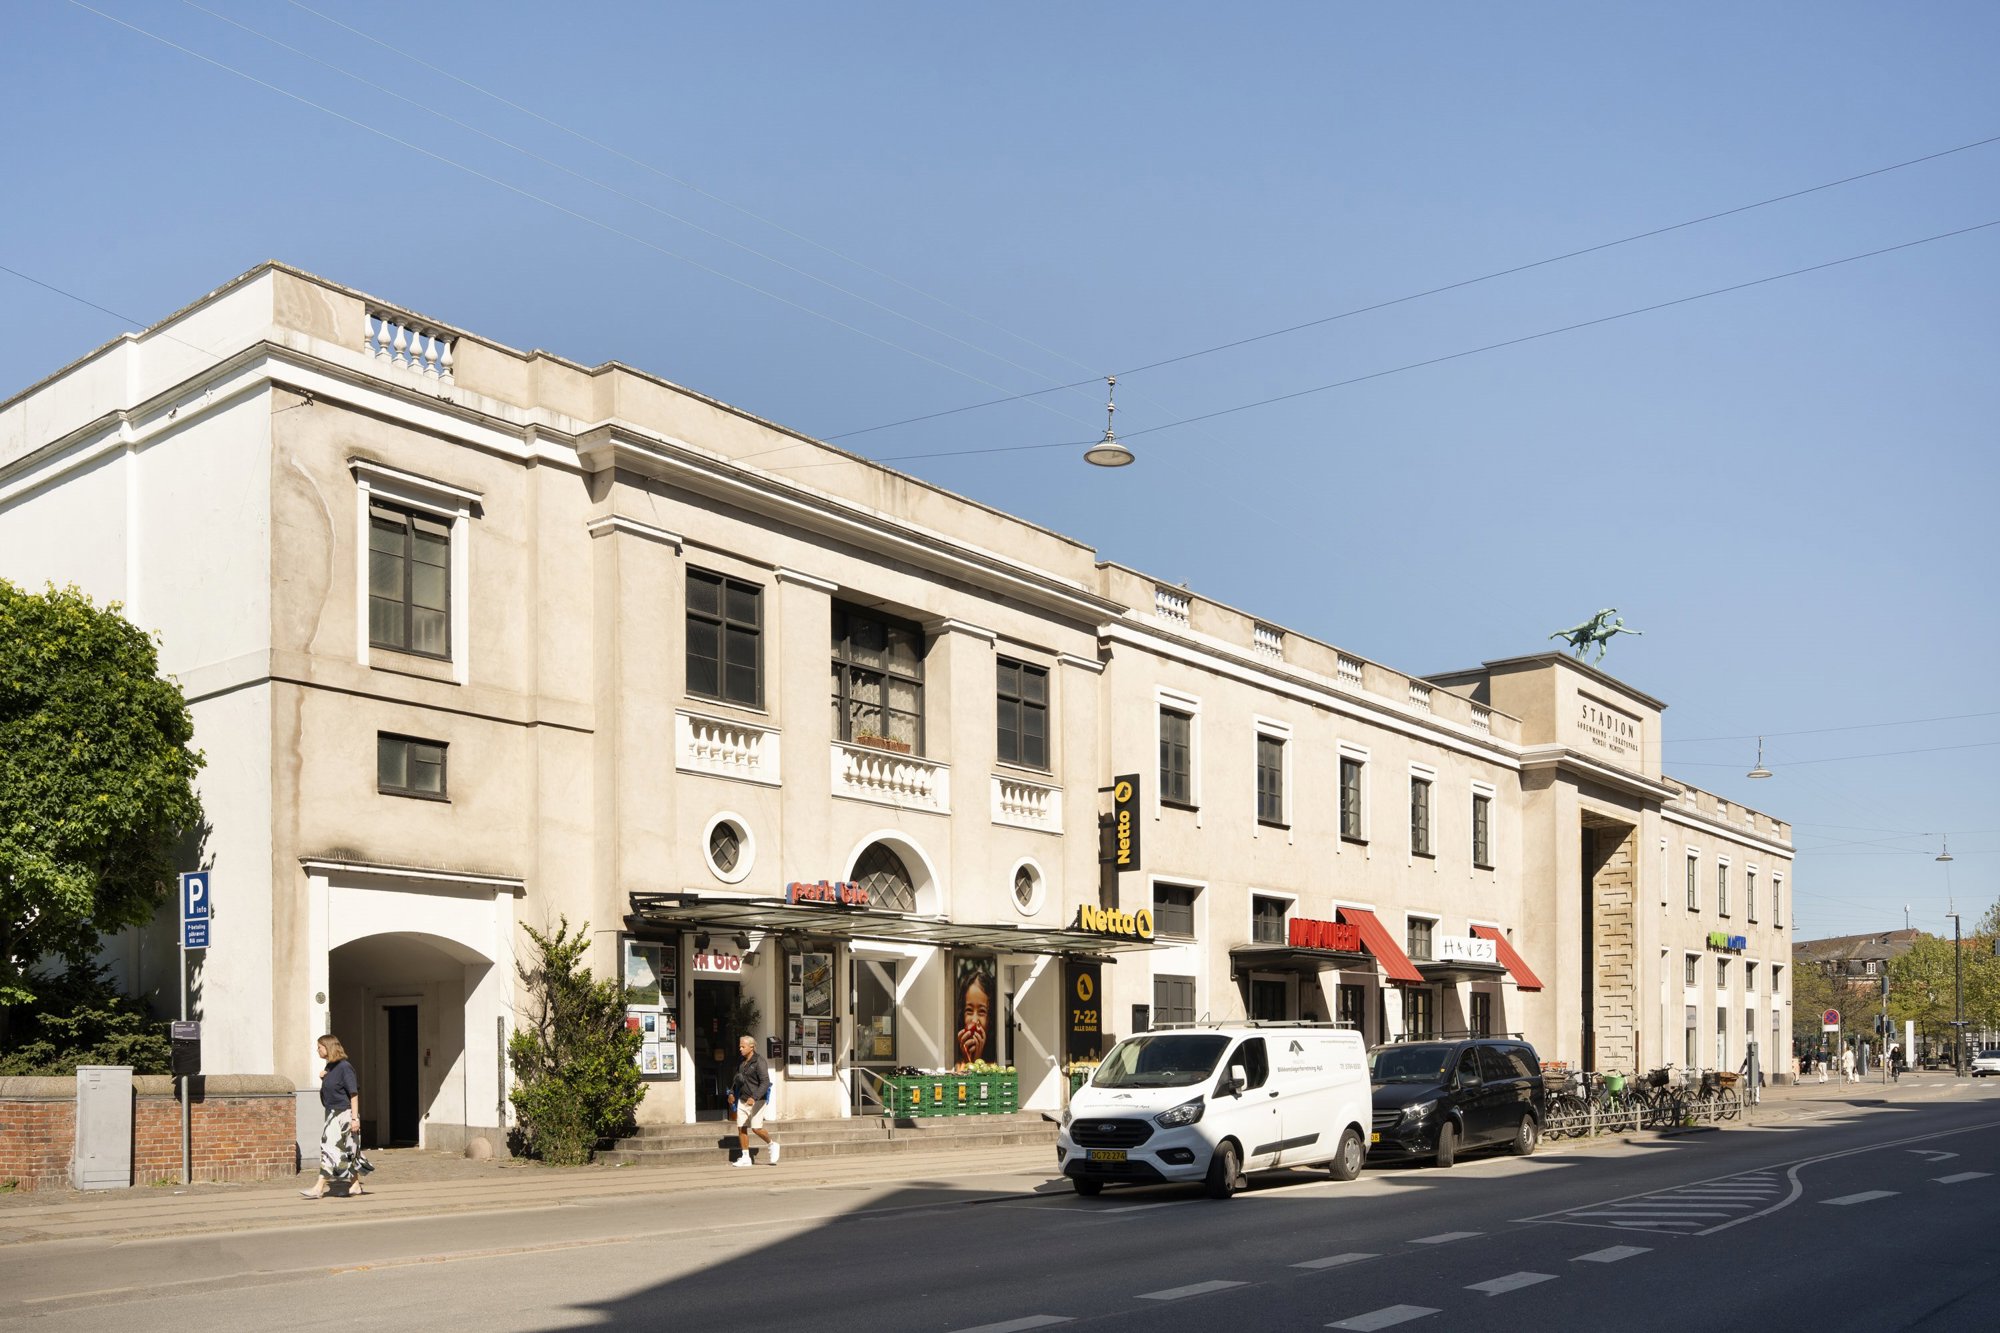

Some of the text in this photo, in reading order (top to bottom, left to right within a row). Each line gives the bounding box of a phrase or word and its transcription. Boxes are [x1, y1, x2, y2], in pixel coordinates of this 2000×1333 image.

[1582, 704, 1634, 739] STADION
[1117, 810, 1131, 864] Netto
[188, 878, 204, 915] P
[786, 880, 869, 905] park bio
[196, 905, 207, 914] info
[1080, 903, 1135, 936] Netto
[713, 948, 740, 971] bio
[1073, 1009, 1098, 1024] 7-22
